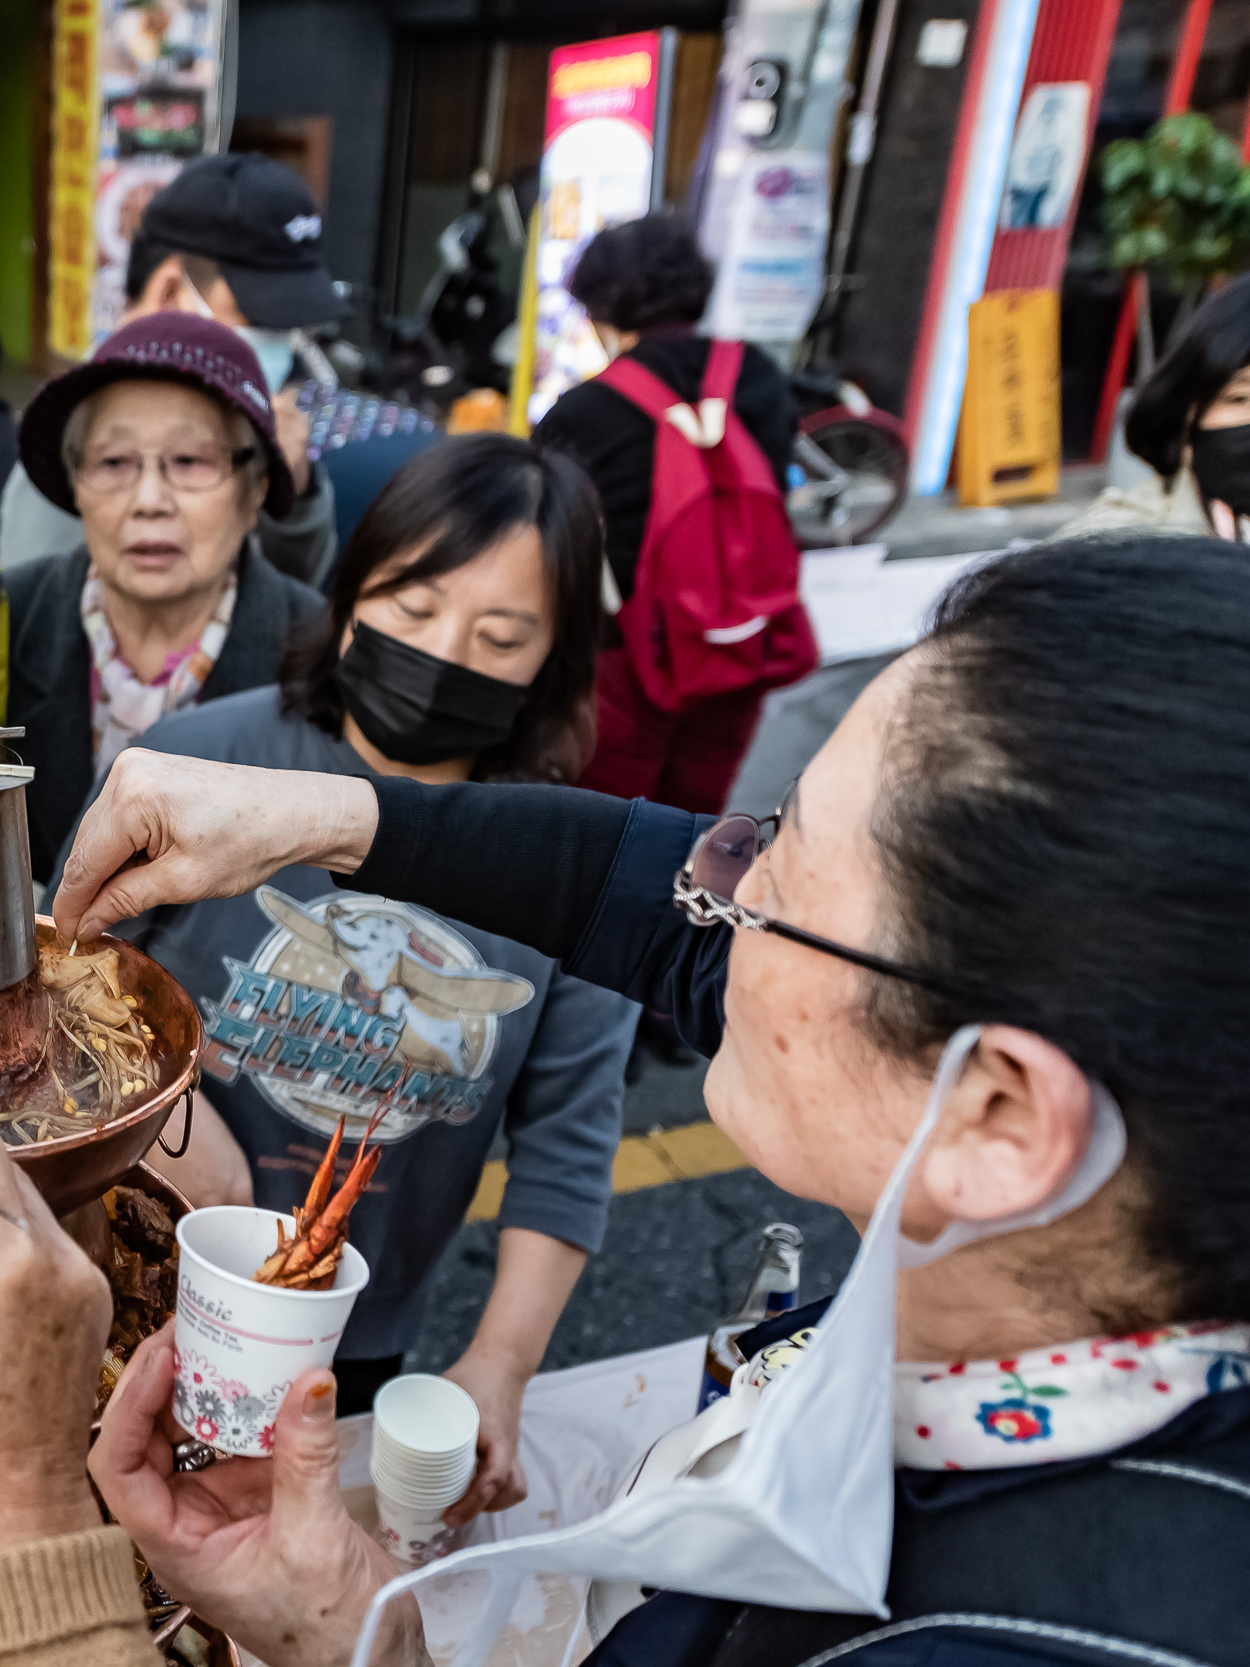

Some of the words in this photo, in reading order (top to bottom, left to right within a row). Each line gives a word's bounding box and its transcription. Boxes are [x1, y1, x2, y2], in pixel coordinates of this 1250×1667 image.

[221, 958, 406, 1062] FLYING
[200, 1000, 494, 1126] ELEPHANTS
[180, 1274, 233, 1321] Classic
